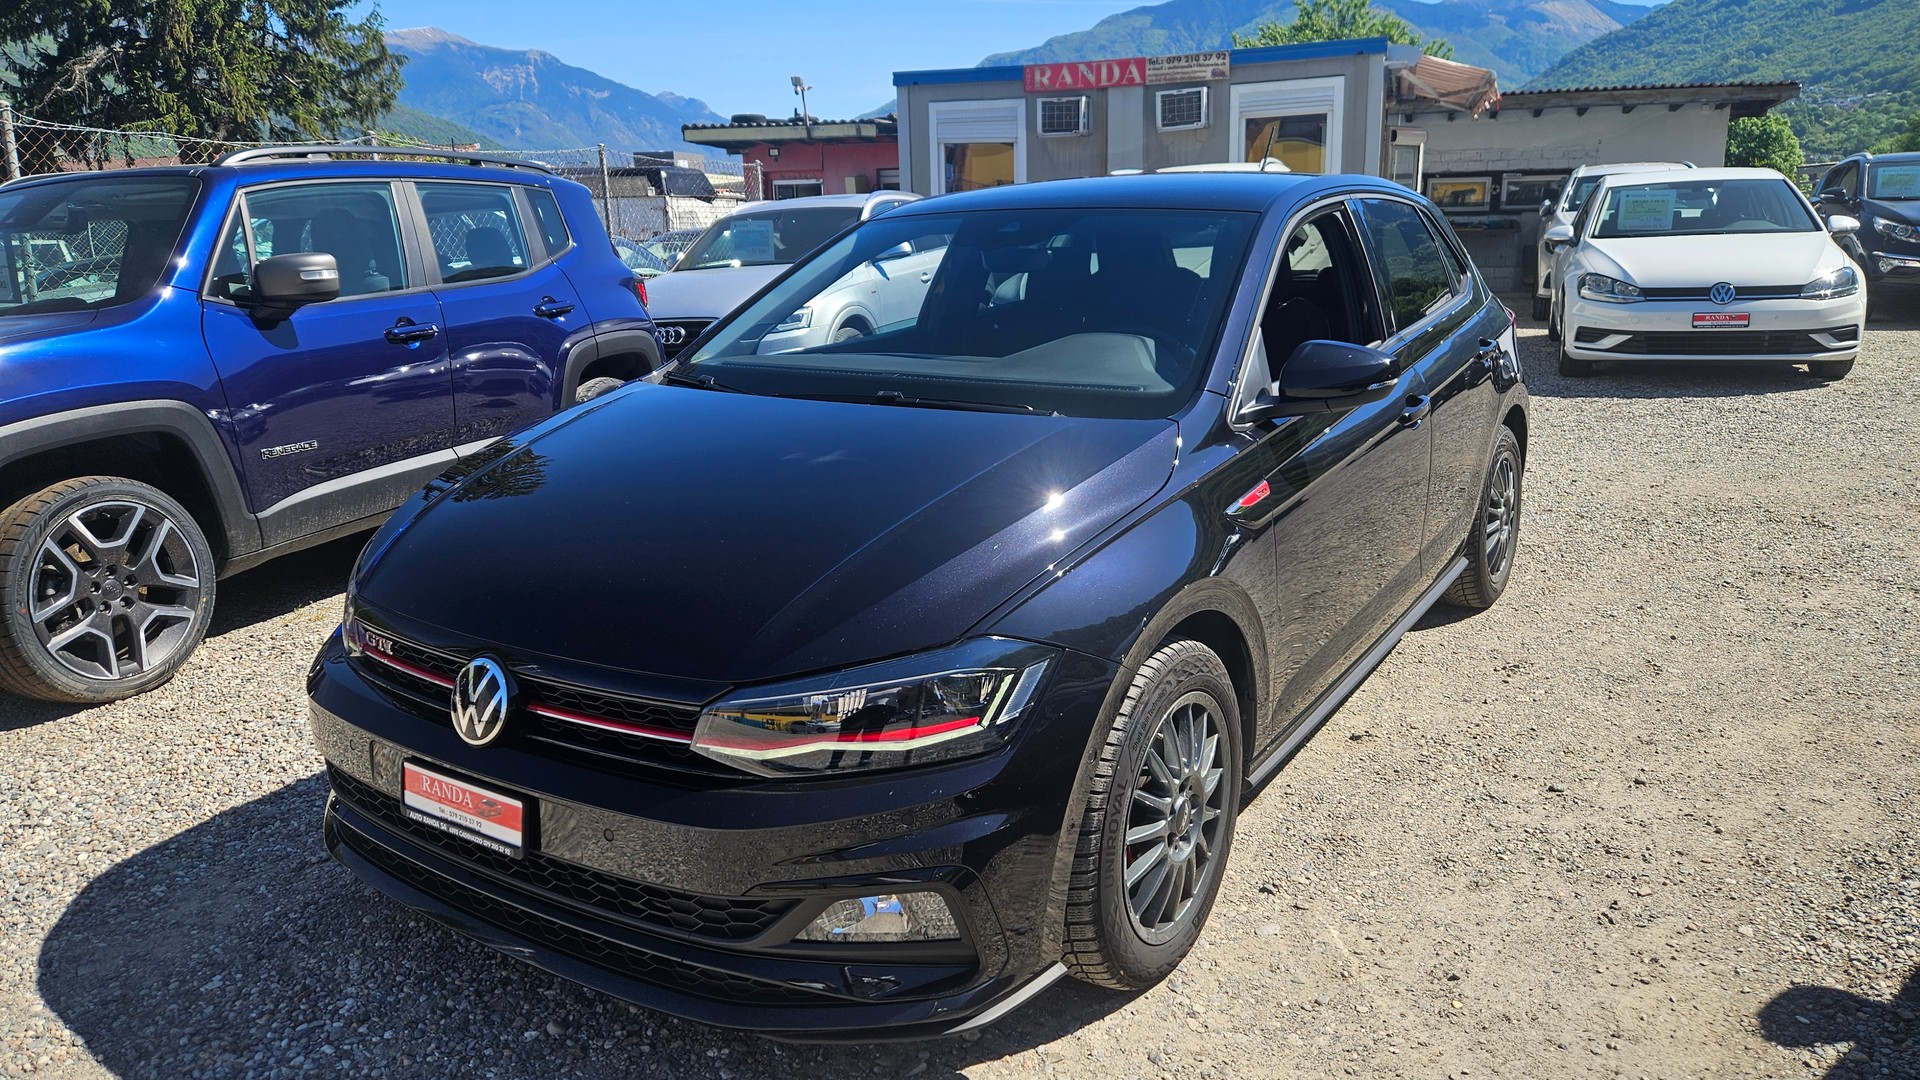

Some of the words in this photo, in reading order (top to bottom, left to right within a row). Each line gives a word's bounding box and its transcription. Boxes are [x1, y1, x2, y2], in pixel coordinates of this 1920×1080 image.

[1166, 56, 1182, 65] 079
[1184, 54, 1200, 63] 210
[1202, 53, 1213, 62] 37
[1216, 52, 1227, 60] 92
[1033, 60, 1144, 90] RANDA
[261, 439, 318, 460] RENEGADE
[365, 630, 394, 656] GTI
[1132, 730, 1144, 752] Shark
[1140, 713, 1151, 731] Skin
[421, 775, 473, 809] RANDA
[410, 811, 423, 822] AUTO
[423, 815, 440, 829] RANDA
[1104, 779, 1129, 889] UNIROYAL
